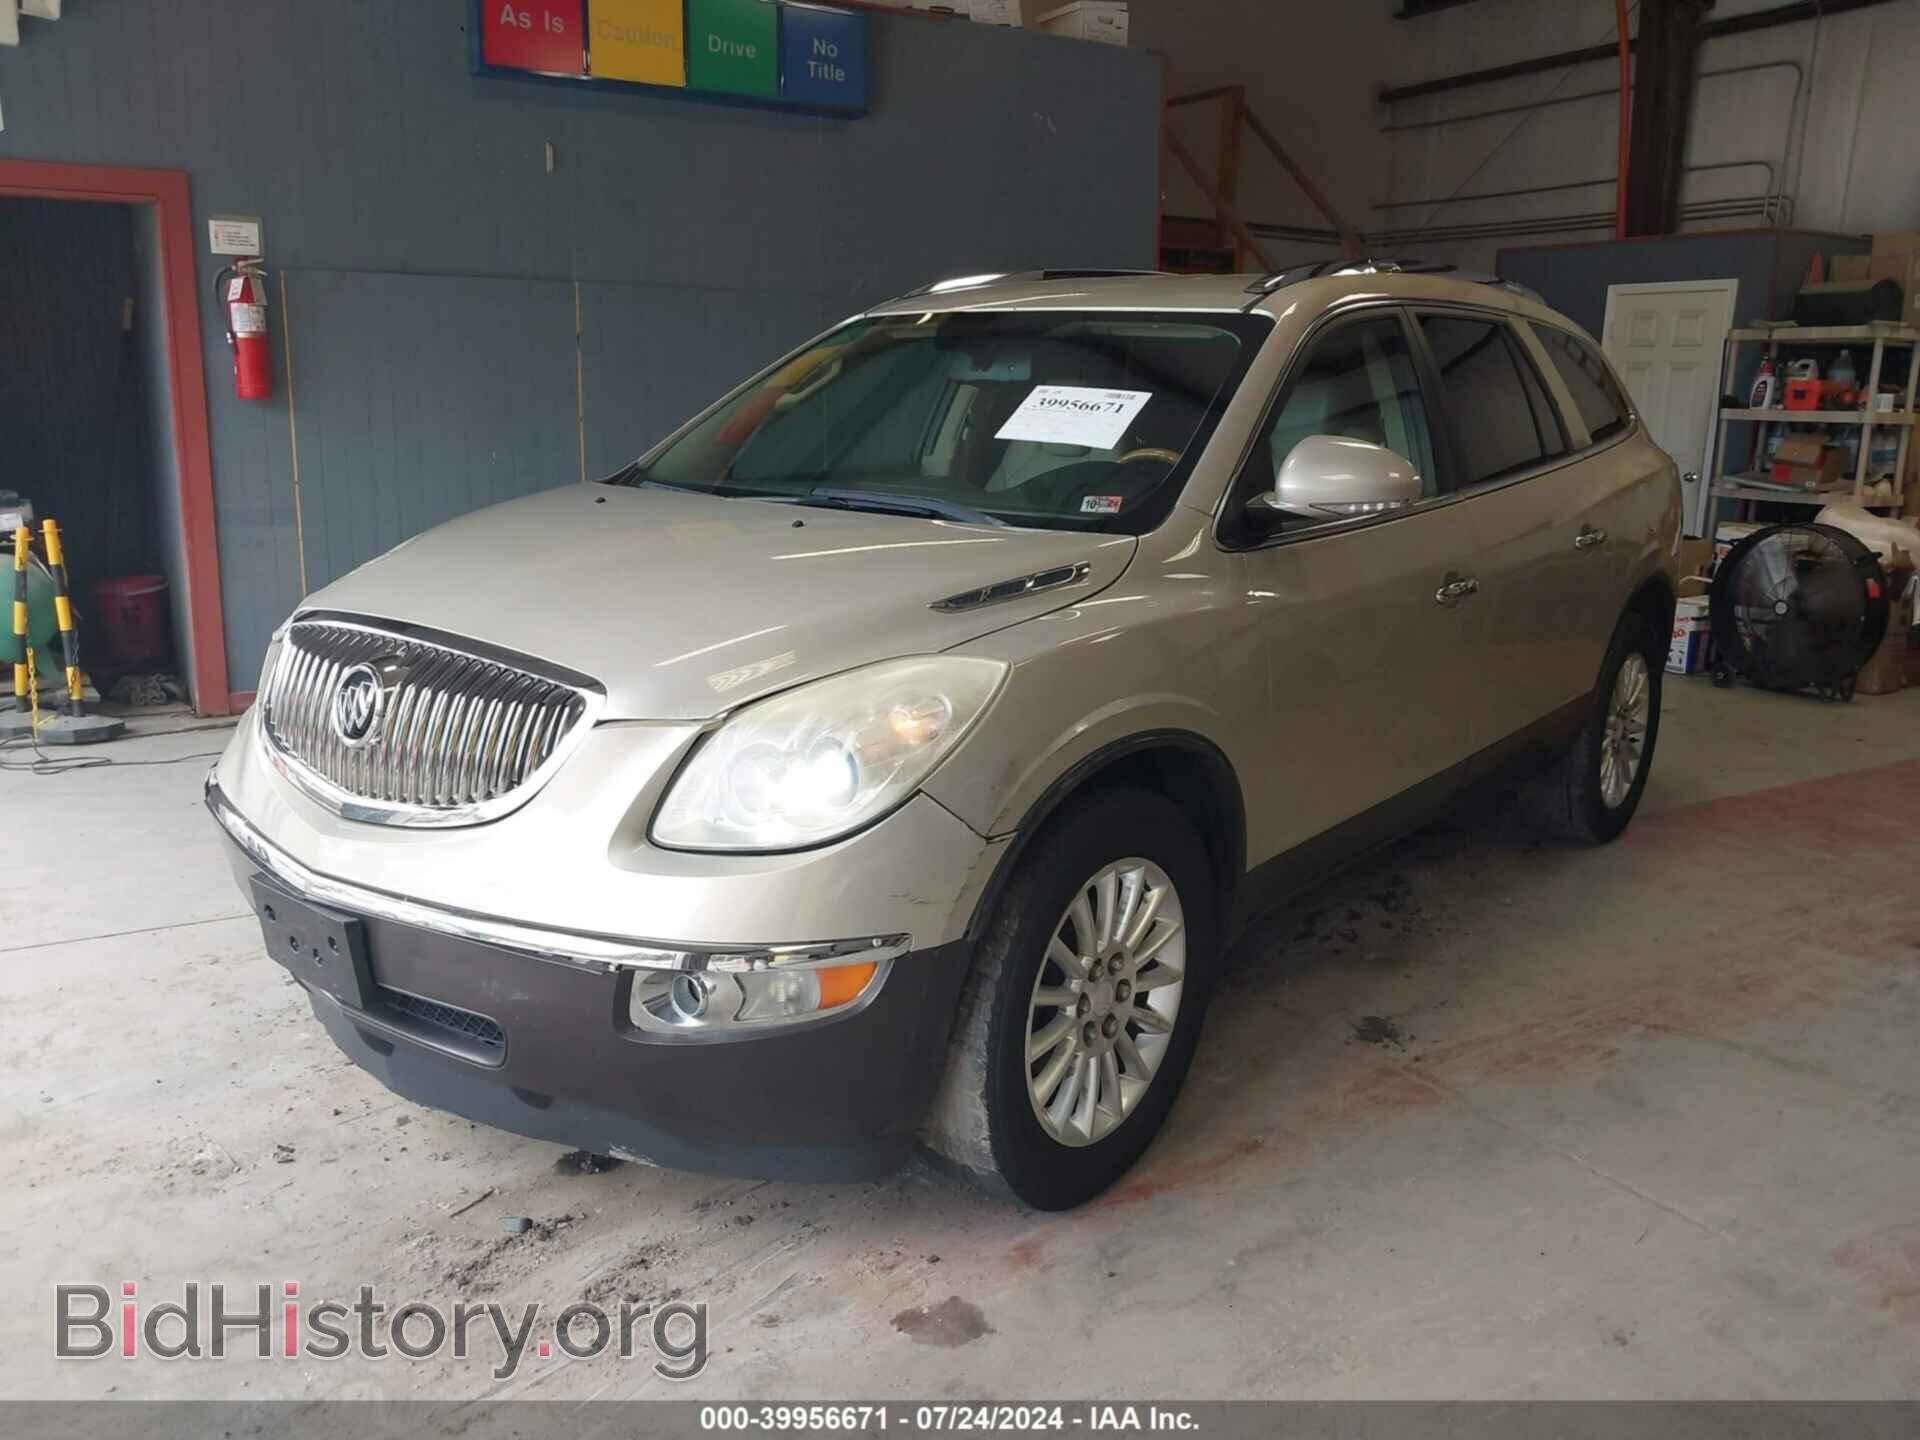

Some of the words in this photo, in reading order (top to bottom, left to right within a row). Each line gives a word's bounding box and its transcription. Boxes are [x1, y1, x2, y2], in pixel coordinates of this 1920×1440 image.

[500, 7, 532, 29] As
[544, 10, 565, 33] Is
[596, 17, 675, 49] Caution
[708, 34, 757, 59] Drive
[813, 38, 838, 58] No
[807, 61, 846, 82] Title
[1033, 397, 1125, 414] 39956671
